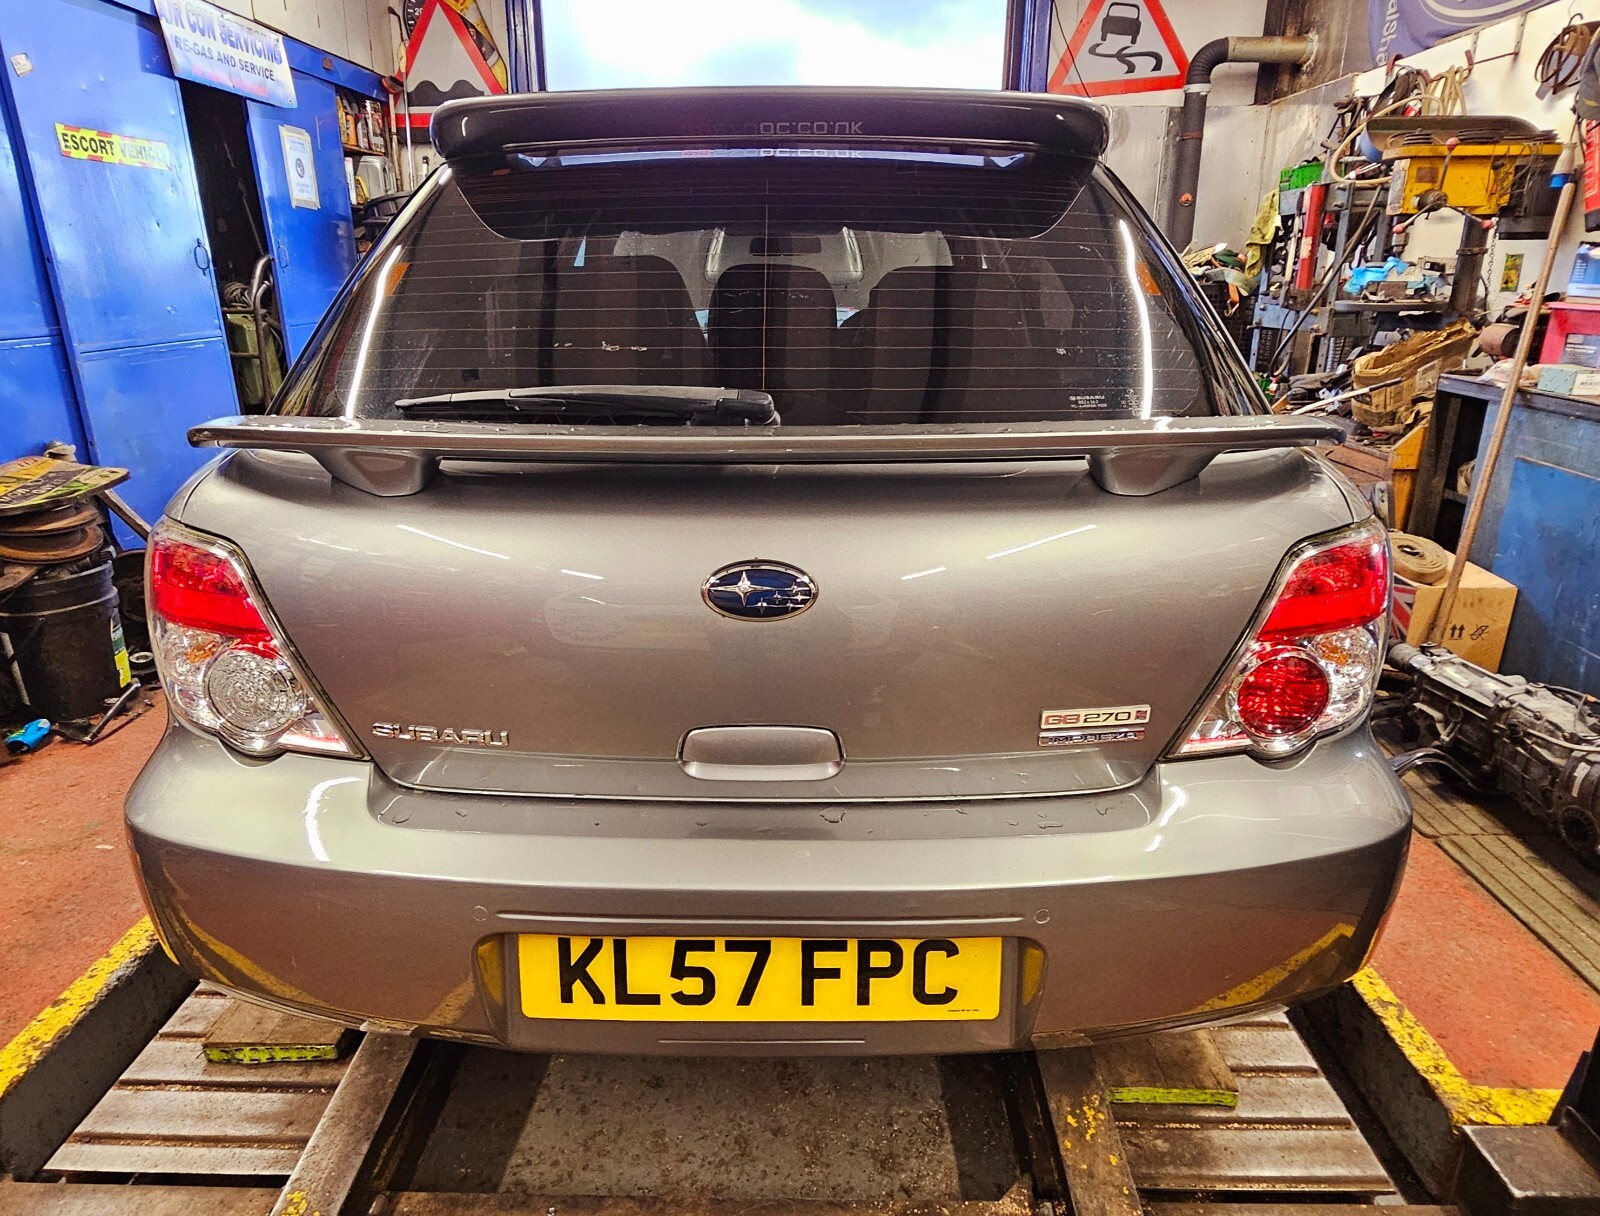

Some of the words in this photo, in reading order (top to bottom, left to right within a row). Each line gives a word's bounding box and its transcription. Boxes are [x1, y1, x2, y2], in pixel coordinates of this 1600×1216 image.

[185, 2, 216, 41] CON
[219, 19, 283, 65] SERVICING
[174, 36, 214, 60] RE-GAS
[217, 51, 236, 68] AND
[239, 58, 275, 81] SERVICE
[61, 132, 115, 156] ESCORT
[371, 722, 509, 747] SUBARU
[1048, 731, 1139, 745] IMPREZA
[557, 936, 772, 1007] KL57
[801, 939, 960, 1006] FPC
